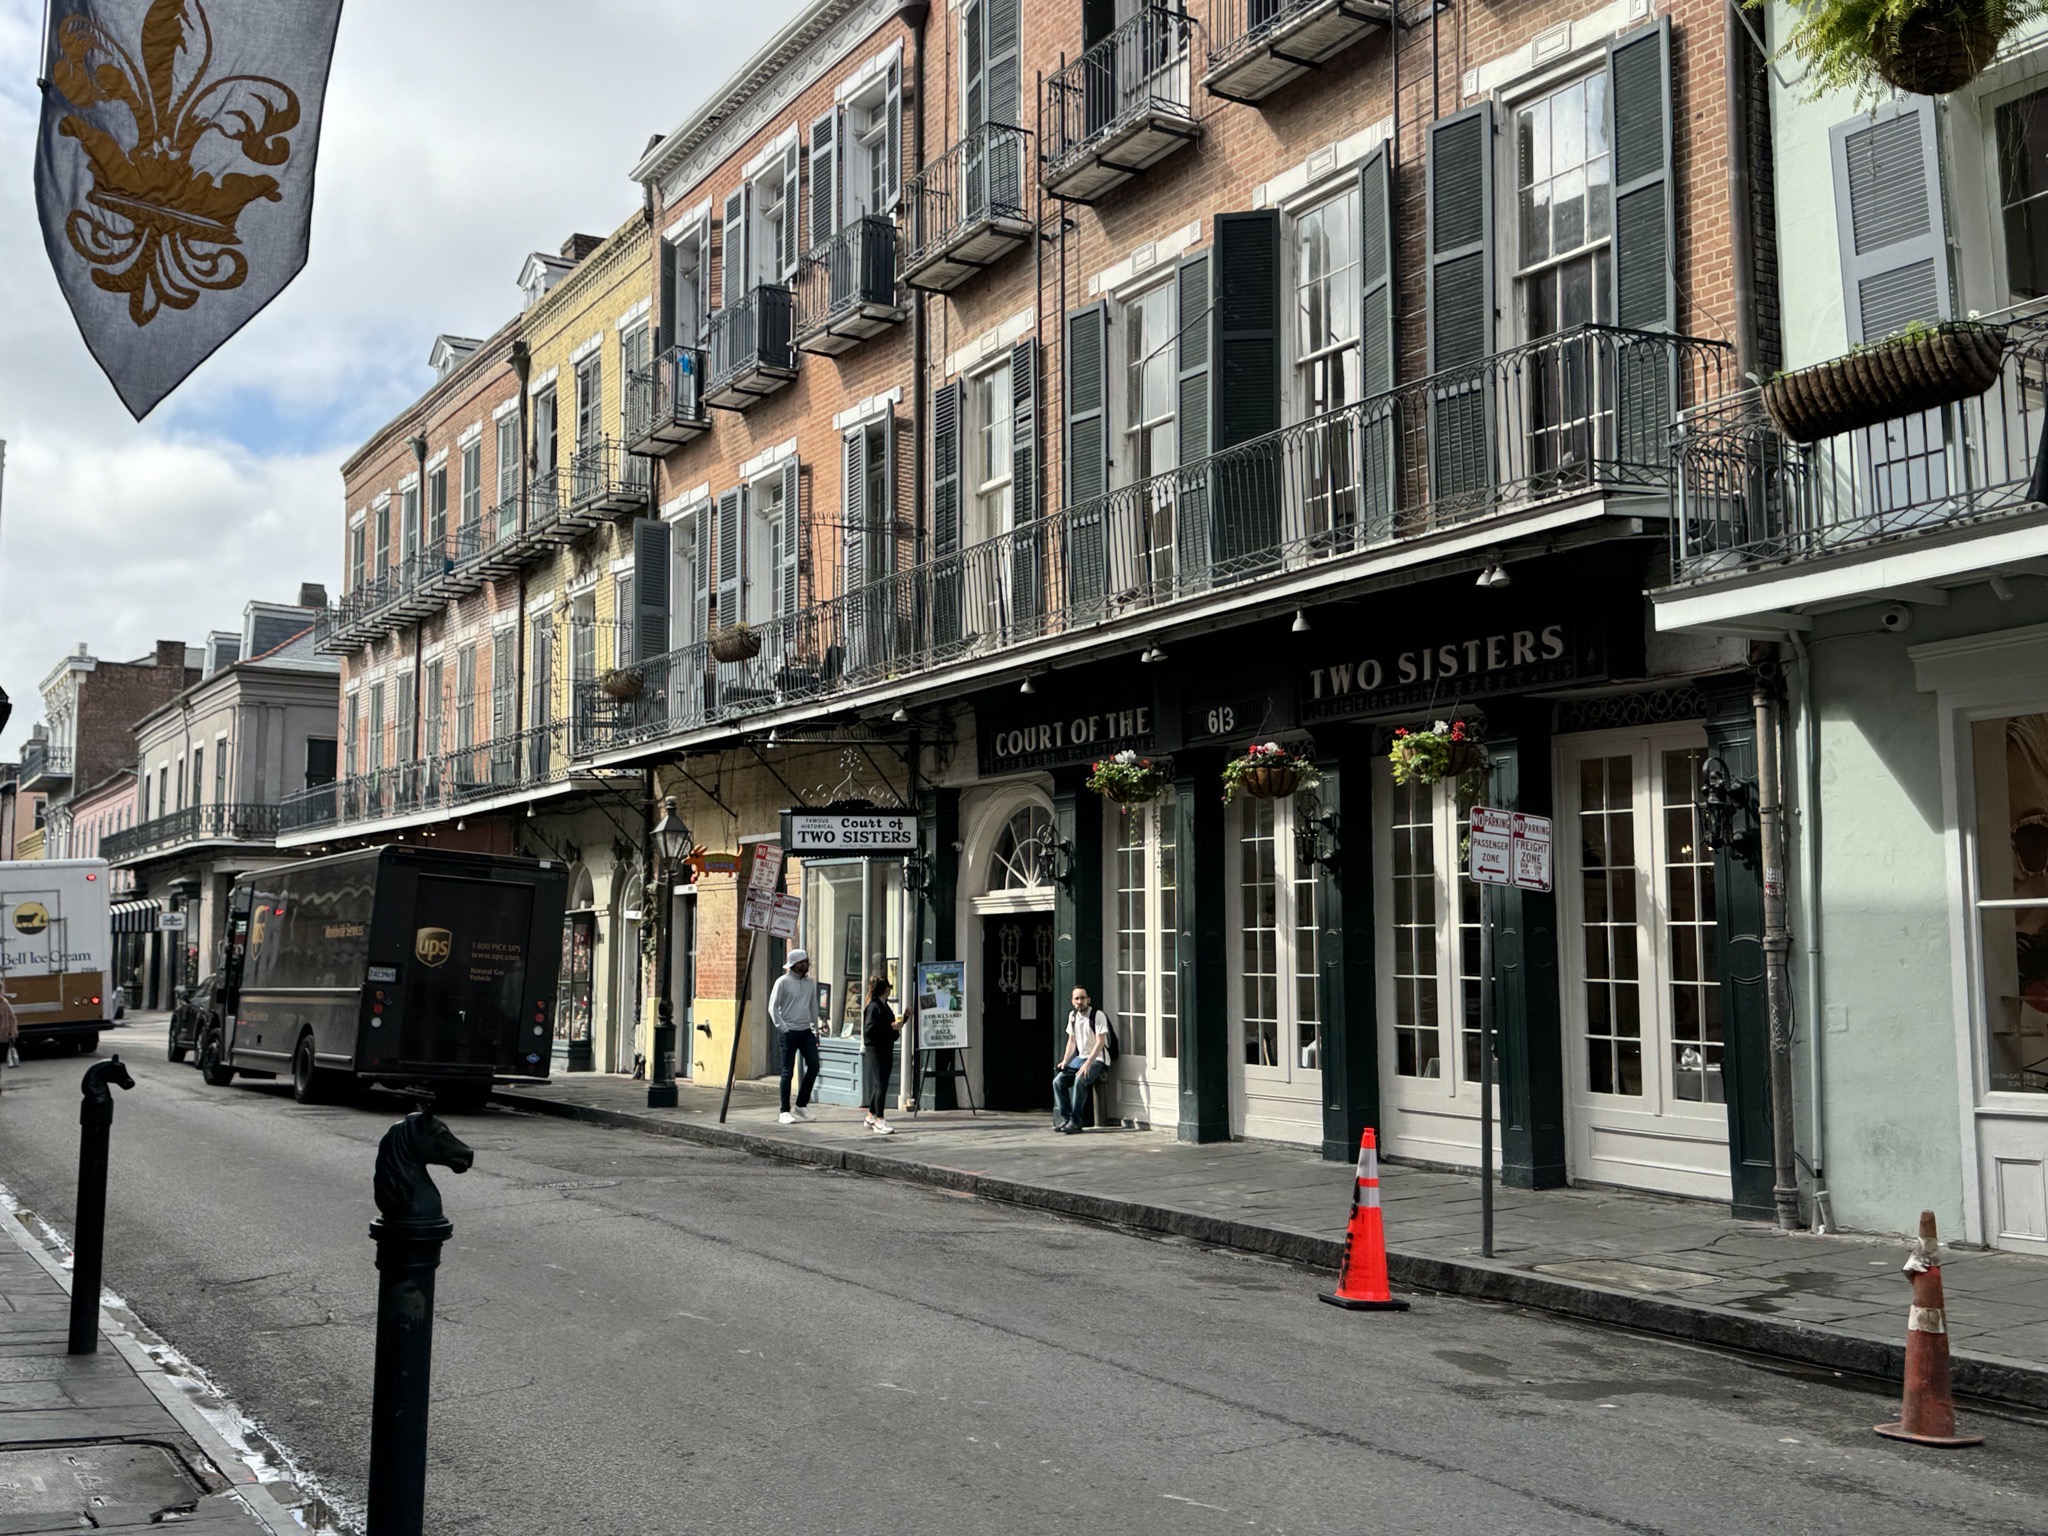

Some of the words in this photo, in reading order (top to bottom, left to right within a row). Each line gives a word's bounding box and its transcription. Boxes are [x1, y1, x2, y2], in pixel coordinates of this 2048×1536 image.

[1310, 659, 1383, 699] TWO
[1398, 624, 1564, 684] SISTERS
[1207, 706, 1235, 734] 613
[995, 721, 1064, 757] COURT
[1070, 715, 1100, 744] OF
[1105, 707, 1150, 740] THE
[841, 817, 882, 829] Court
[888, 818, 903, 831] of
[1472, 812, 1484, 828] NO
[1485, 815, 1510, 830] PARKING
[1514, 819, 1525, 834] NO
[1525, 822, 1551, 836] PARKING
[797, 830, 836, 843] TWO
[842, 830, 911, 843] SISTERS
[1473, 838, 1509, 851] PASSENGER
[1516, 840, 1548, 854] FREIGHT
[758, 847, 766, 857] NO
[1481, 852, 1500, 864] ZONE
[1521, 852, 1542, 865] ZONE
[418, 939, 448, 961] ups
[476, 942, 490, 950] 800
[491, 943, 507, 952] PICK
[508, 944, 521, 952] UPS
[2, 952, 27, 966] Bell
[30, 951, 48, 963] Ice
[49, 950, 91, 963] Cream
[471, 952, 520, 961] www.ups.com
[470, 967, 492, 975] Natural
[470, 974, 492, 982] Vehicle
